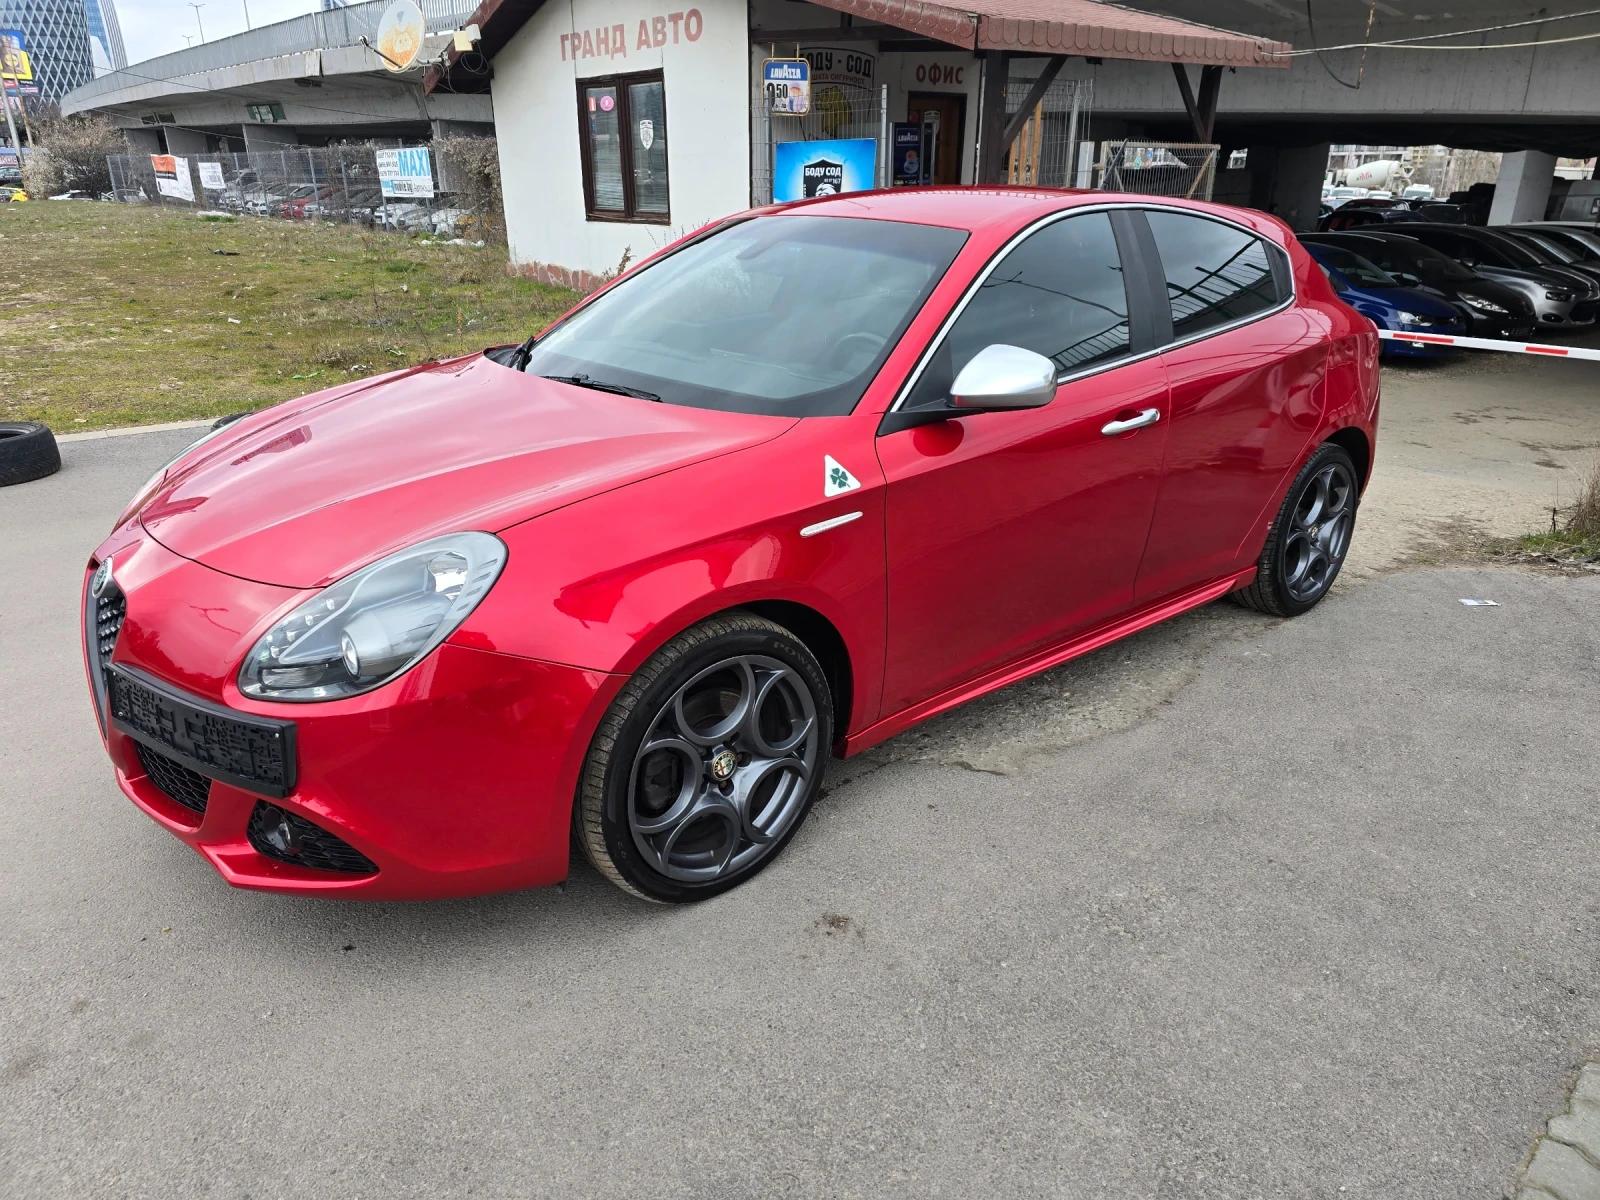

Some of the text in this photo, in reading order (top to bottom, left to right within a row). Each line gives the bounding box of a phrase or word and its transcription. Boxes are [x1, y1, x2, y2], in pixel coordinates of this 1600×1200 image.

[560, 8, 703, 61] ГРАНД АВТО
[770, 64, 802, 79] LAVAZZA
[811, 72, 829, 81] ШАТА
[846, 54, 871, 78] СОД
[916, 62, 964, 85] ОФИС
[397, 149, 431, 177] MAXI
[805, 167, 842, 178] БОДУ СОД
